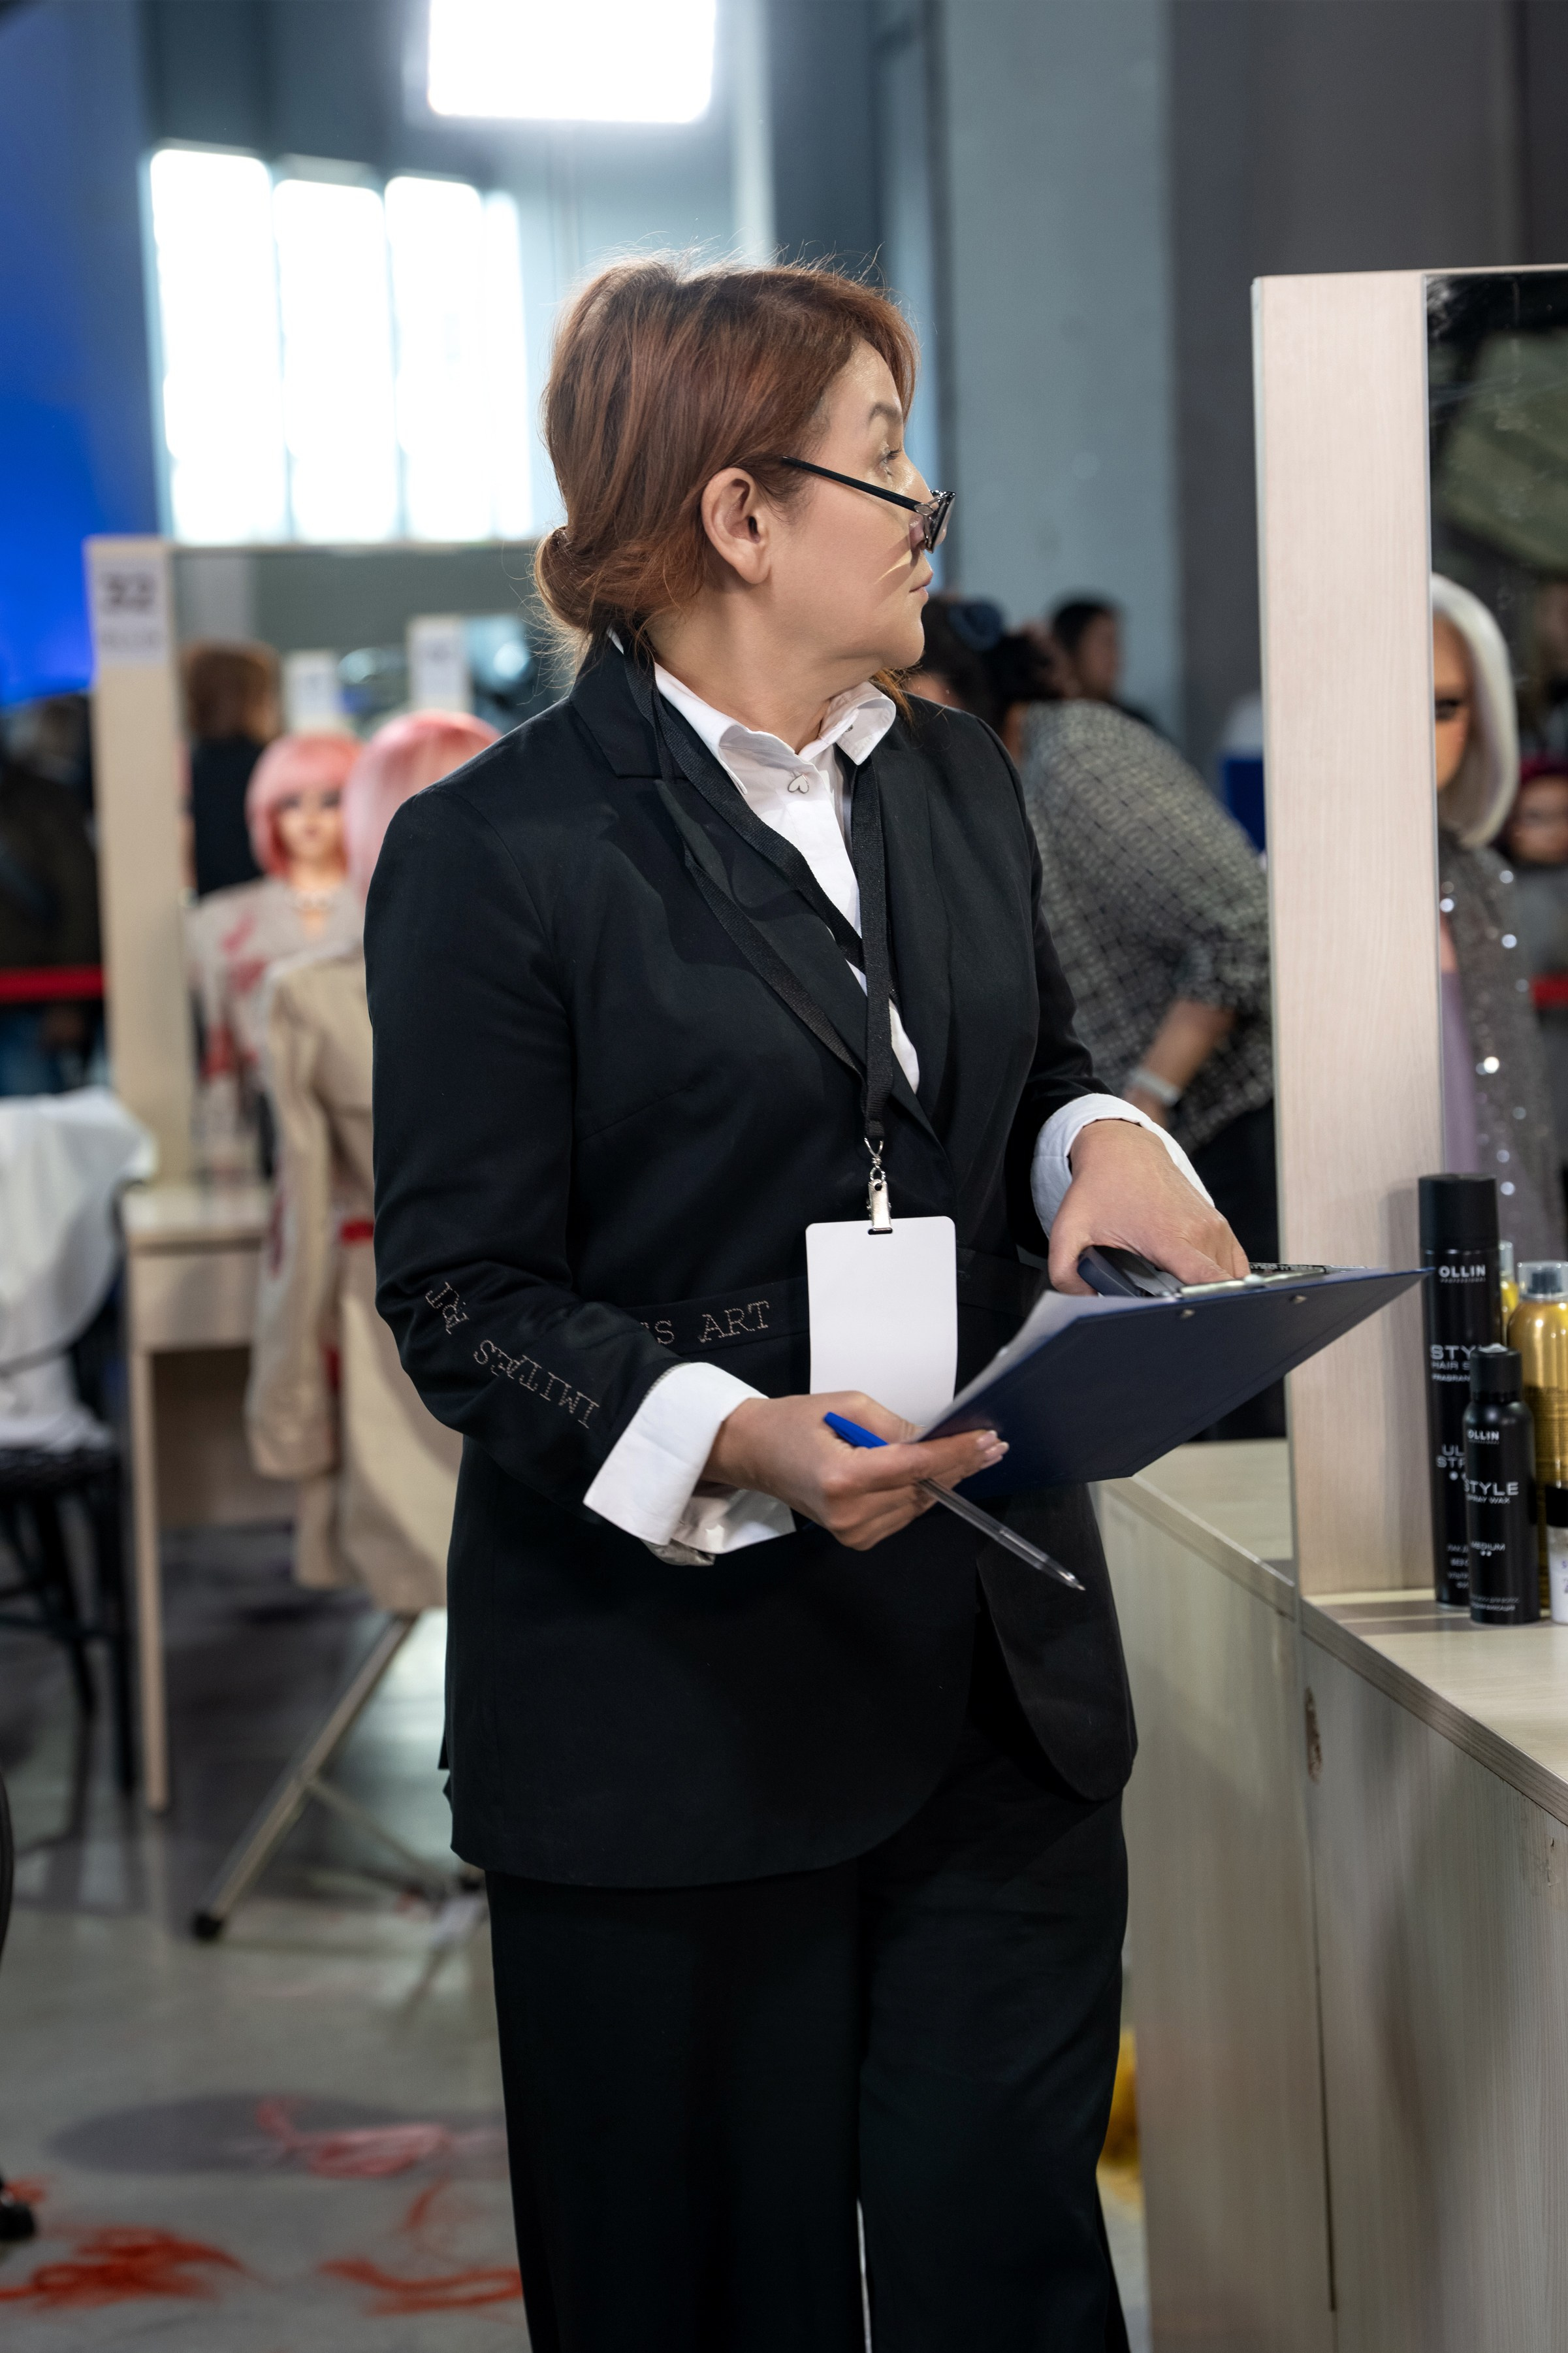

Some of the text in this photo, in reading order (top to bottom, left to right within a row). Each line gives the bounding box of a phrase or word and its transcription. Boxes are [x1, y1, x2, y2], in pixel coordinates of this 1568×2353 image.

[1438, 1264, 1486, 1278] OLLIN
[424, 1281, 470, 1335] ART
[697, 1300, 770, 1344] ART
[1430, 1344, 1477, 1360] STY
[1431, 1361, 1471, 1371] HAIR S
[1432, 1372, 1471, 1382] FRAGRAN
[1467, 1429, 1499, 1440] OLLIN
[1442, 1444, 1465, 1456] UL
[1464, 1479, 1519, 1496] STYLE
[1471, 1541, 1506, 1551] MEDIUM
